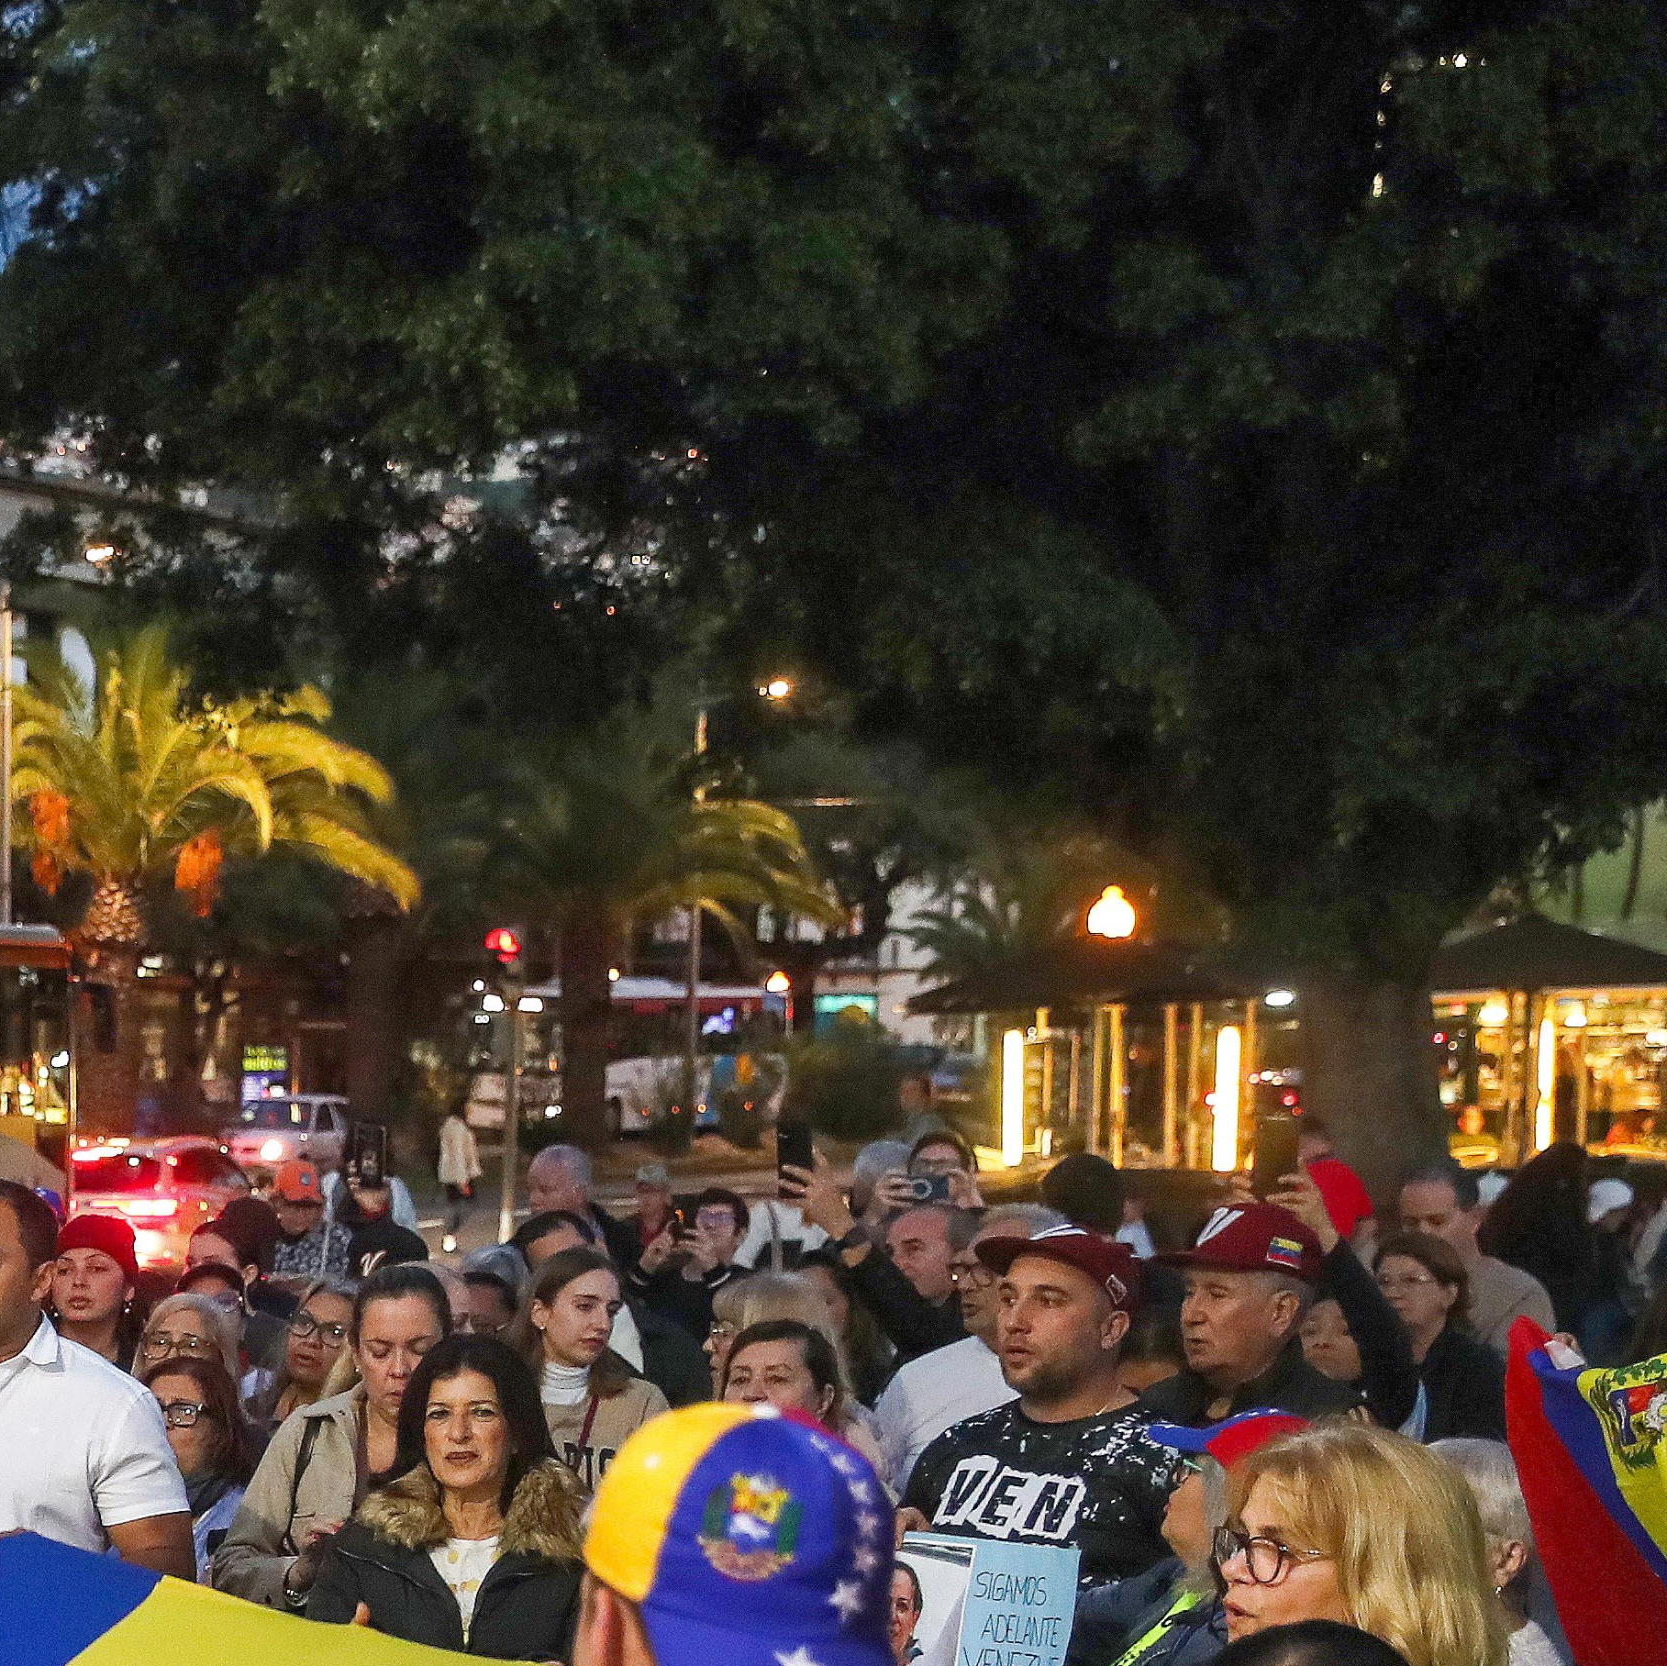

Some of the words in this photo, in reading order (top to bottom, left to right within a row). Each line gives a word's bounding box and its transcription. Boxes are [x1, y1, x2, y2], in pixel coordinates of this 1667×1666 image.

[942, 1465, 1080, 1536] VEN
[973, 1570, 1048, 1606] SIGAMOS
[980, 1613, 1062, 1648] ADELANTE
